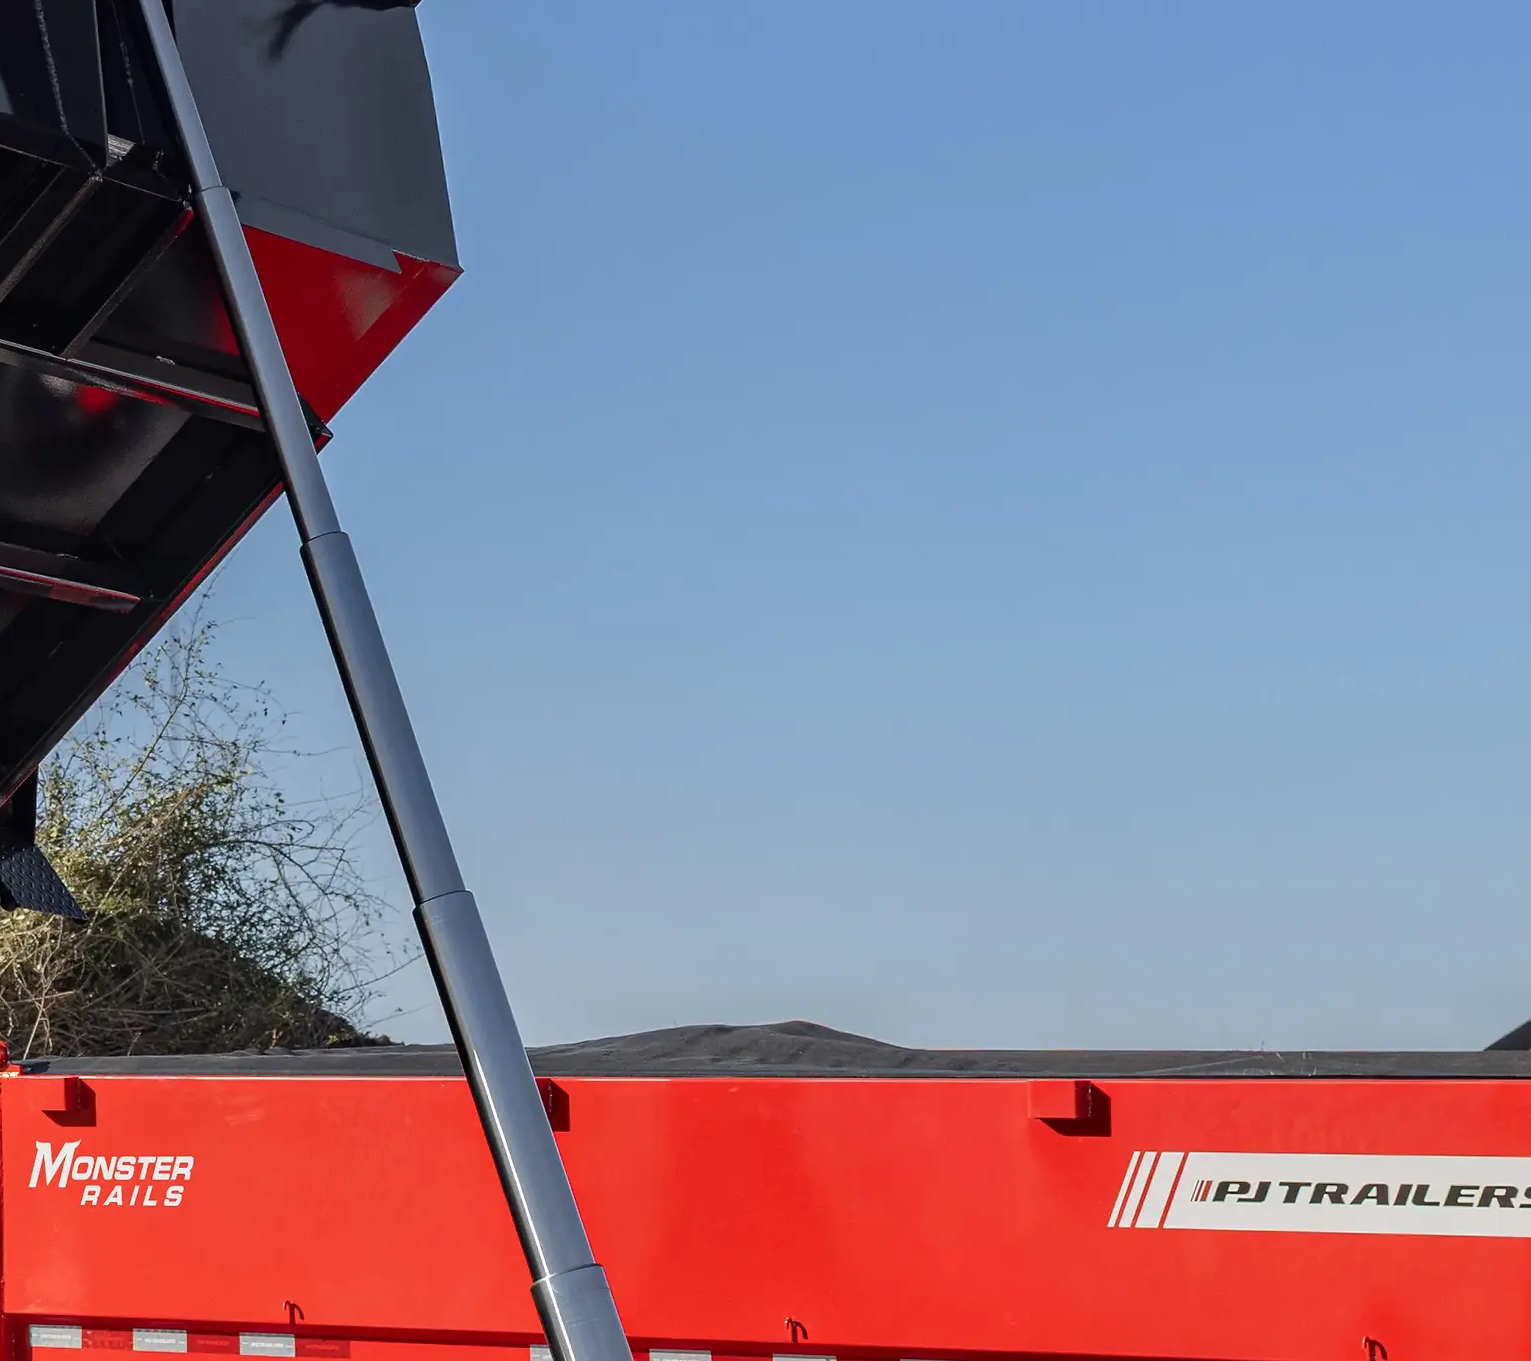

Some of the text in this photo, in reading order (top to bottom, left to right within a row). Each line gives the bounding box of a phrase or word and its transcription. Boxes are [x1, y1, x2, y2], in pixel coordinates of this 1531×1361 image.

[29, 1140, 194, 1188] MONSTER
[80, 1185, 184, 1206] RAILS
[1213, 1181, 1274, 1203] PJ
